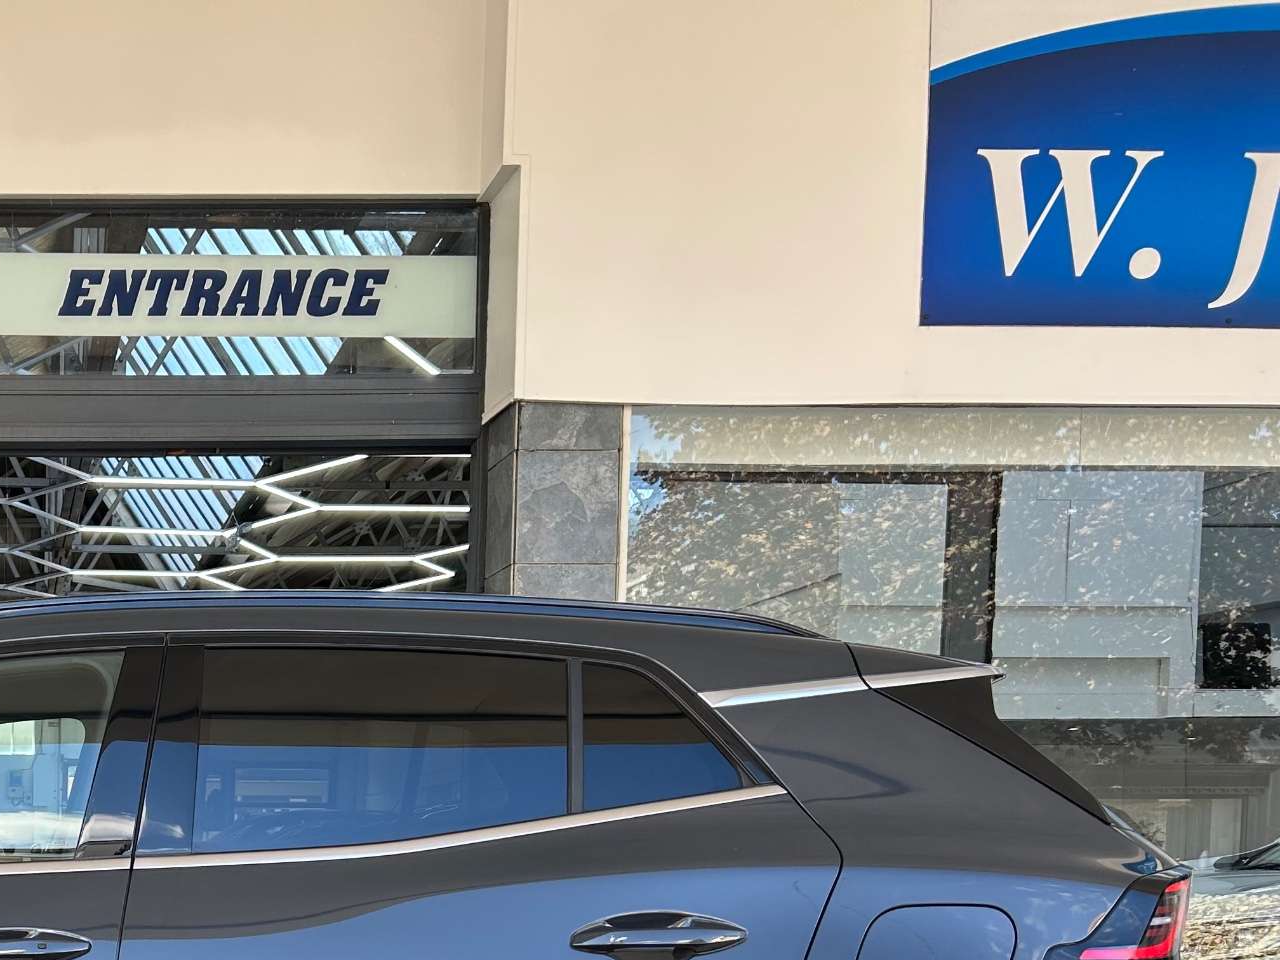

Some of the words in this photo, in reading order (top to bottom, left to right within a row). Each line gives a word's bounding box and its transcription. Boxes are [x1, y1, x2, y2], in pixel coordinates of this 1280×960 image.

[976, 148, 1165, 281] W.
[1207, 151, 1280, 310] J
[57, 267, 391, 318] ENTRANCE
